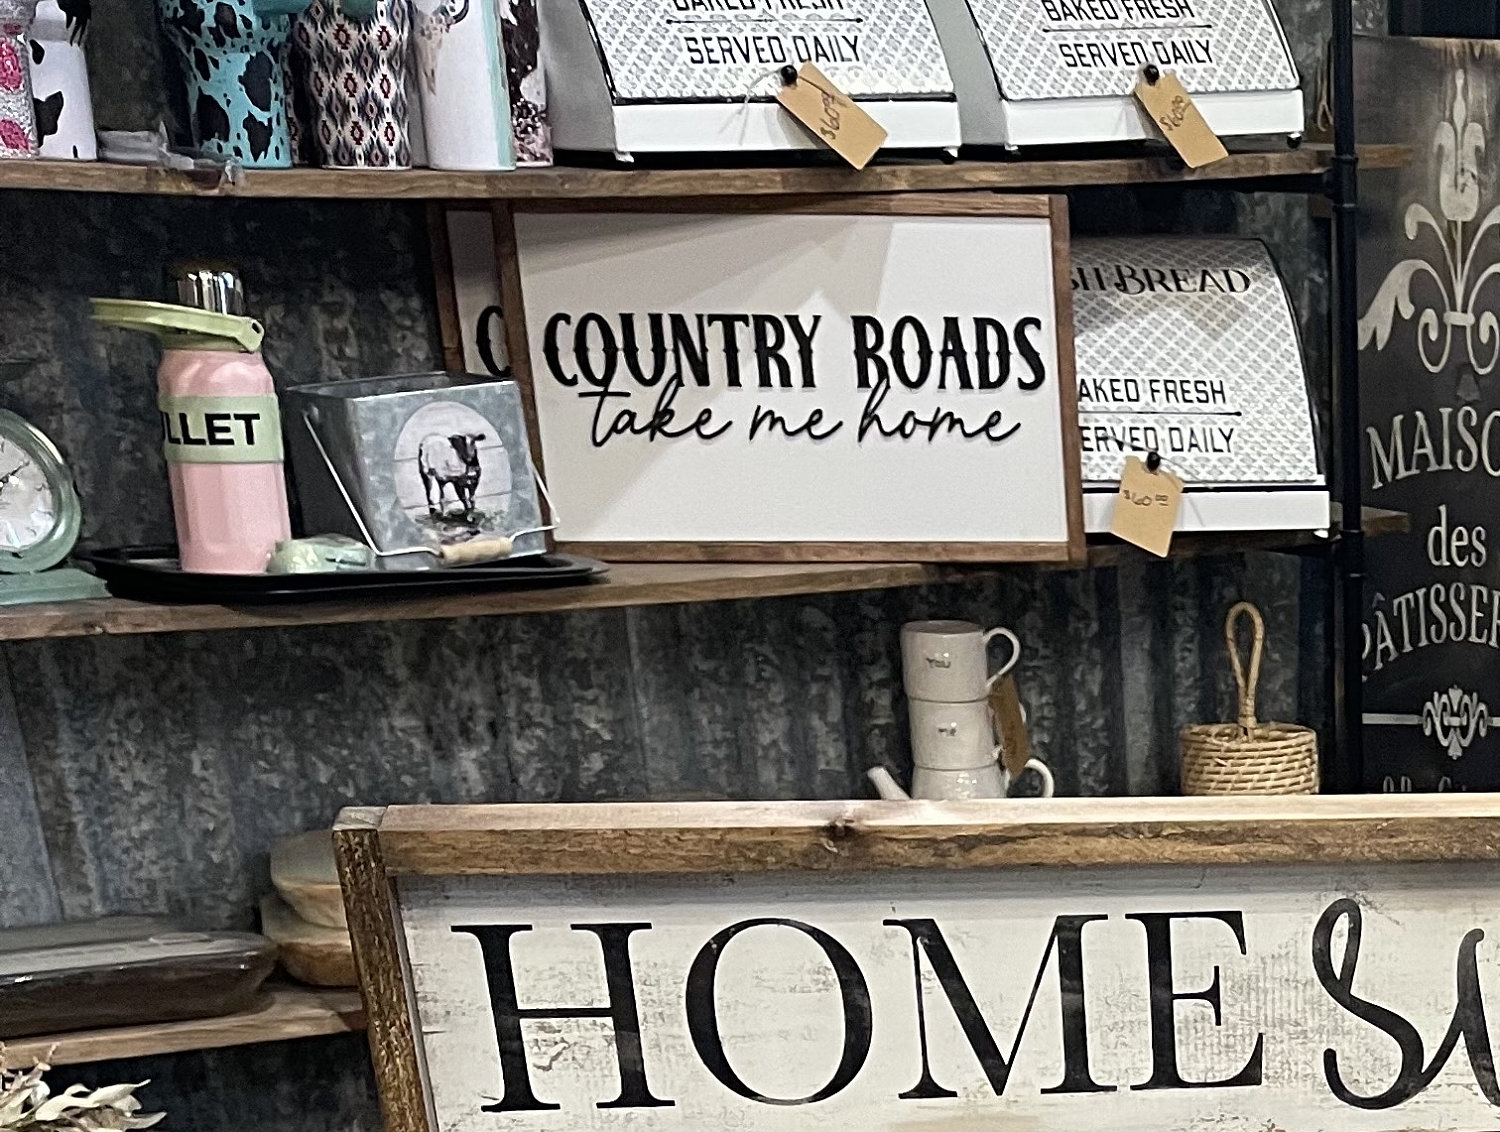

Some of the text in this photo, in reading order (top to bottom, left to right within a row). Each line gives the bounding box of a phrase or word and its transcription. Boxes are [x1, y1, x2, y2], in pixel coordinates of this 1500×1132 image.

[684, 35, 861, 64] SERVED DAILY
[1058, 39, 1213, 68] SERVED DAILY
[1114, 264, 1251, 296] BREAD
[542, 311, 822, 389] COUNTRY
[850, 314, 1046, 391] ROADS
[1077, 378, 1227, 404] AKED FRESH
[577, 372, 1022, 448] take me home
[161, 411, 261, 446] LLET
[1078, 425, 1235, 453] ERVED DAILY
[1427, 503, 1488, 568] des
[449, 909, 1267, 1114] HOME
